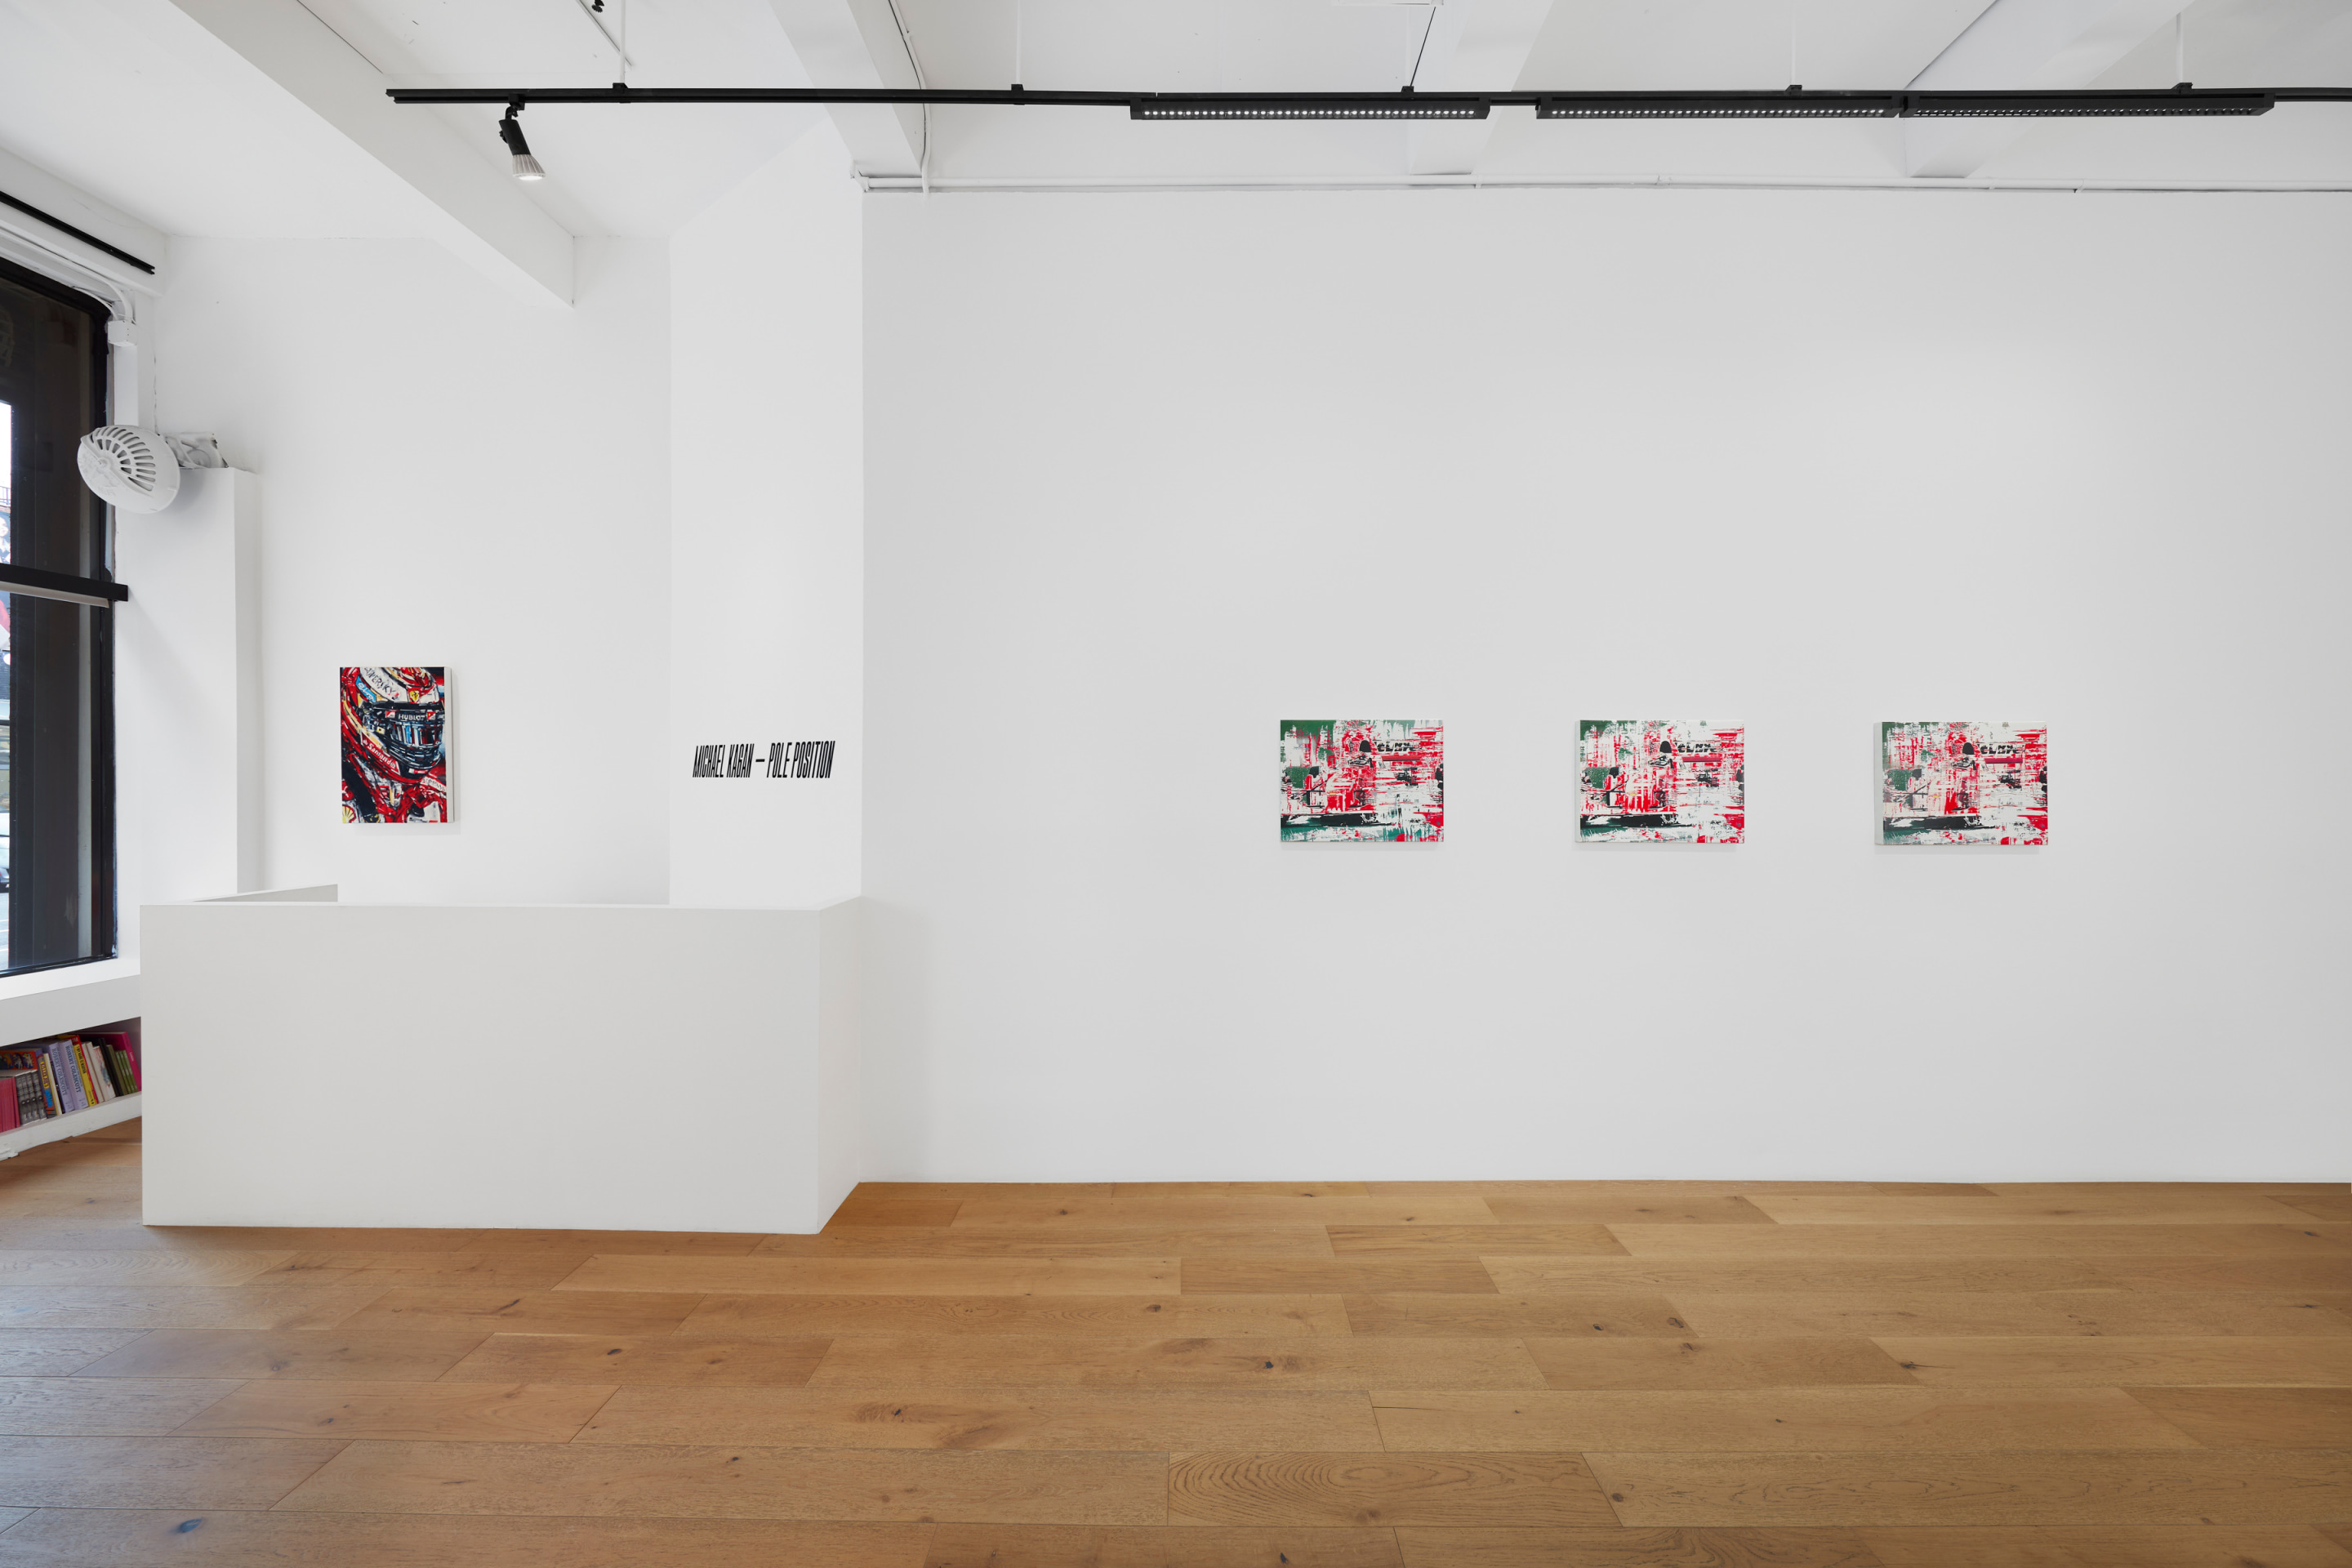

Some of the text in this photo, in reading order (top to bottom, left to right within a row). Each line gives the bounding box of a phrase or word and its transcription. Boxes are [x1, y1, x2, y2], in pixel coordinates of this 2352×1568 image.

[692, 744, 726, 778] MICHAEL
[726, 743, 755, 778] KAGAN
[766, 742, 793, 778] POLE
[791, 740, 836, 779] POSITION
